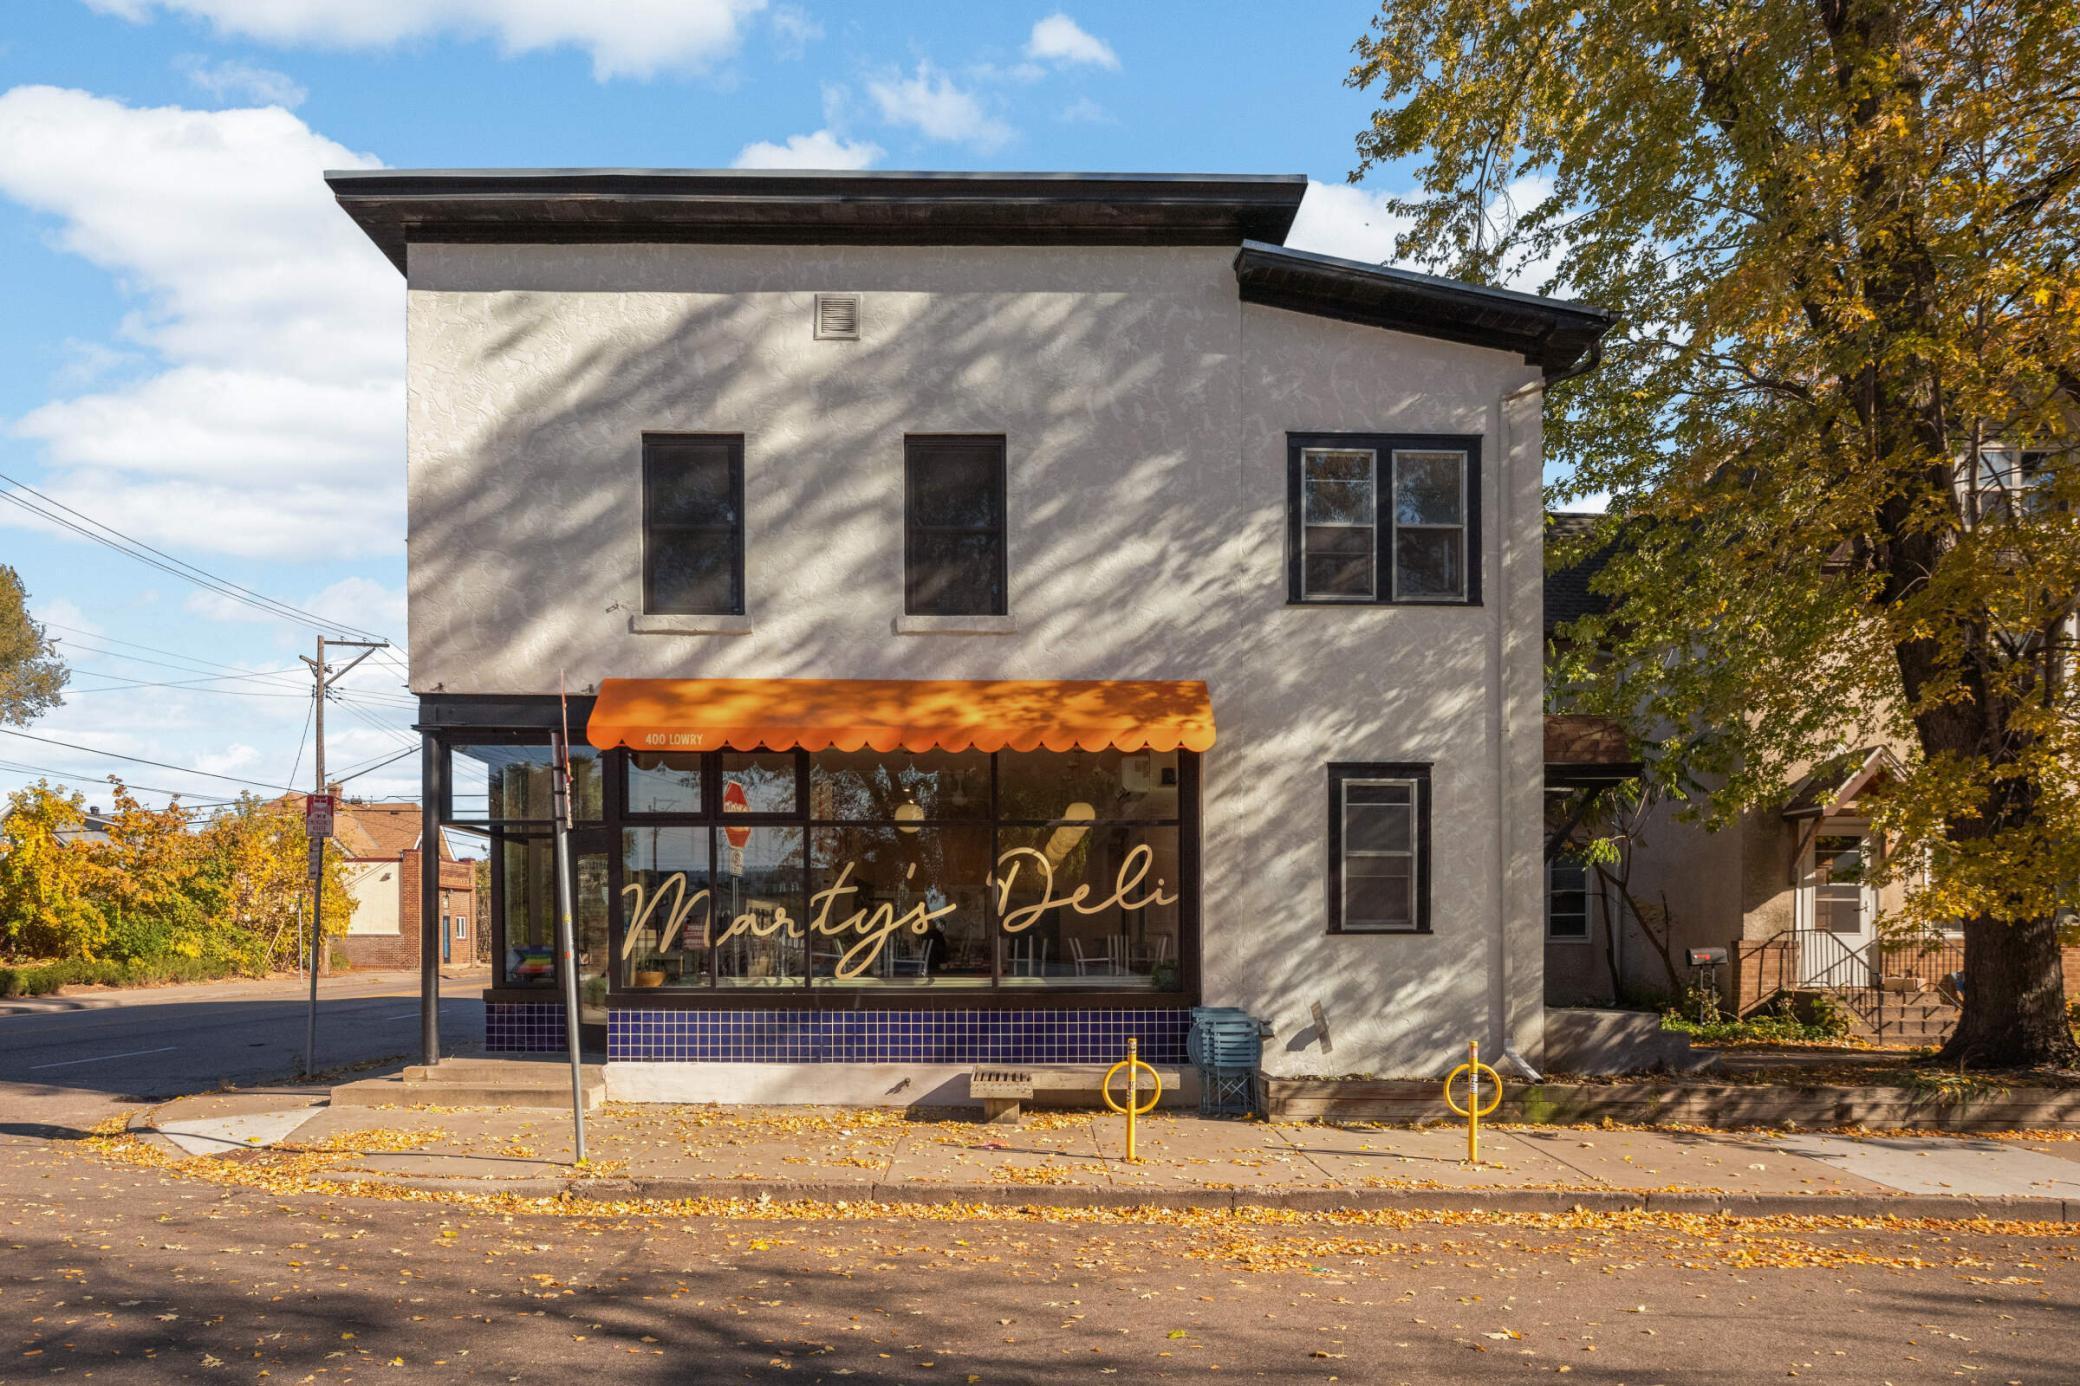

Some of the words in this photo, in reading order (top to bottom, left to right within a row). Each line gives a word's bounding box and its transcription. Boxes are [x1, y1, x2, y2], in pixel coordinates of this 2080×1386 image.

[646, 733, 667, 745] 400
[669, 733, 703, 745] LOWRY
[621, 861, 957, 980] Marty's
[986, 843, 1179, 933] Deli
